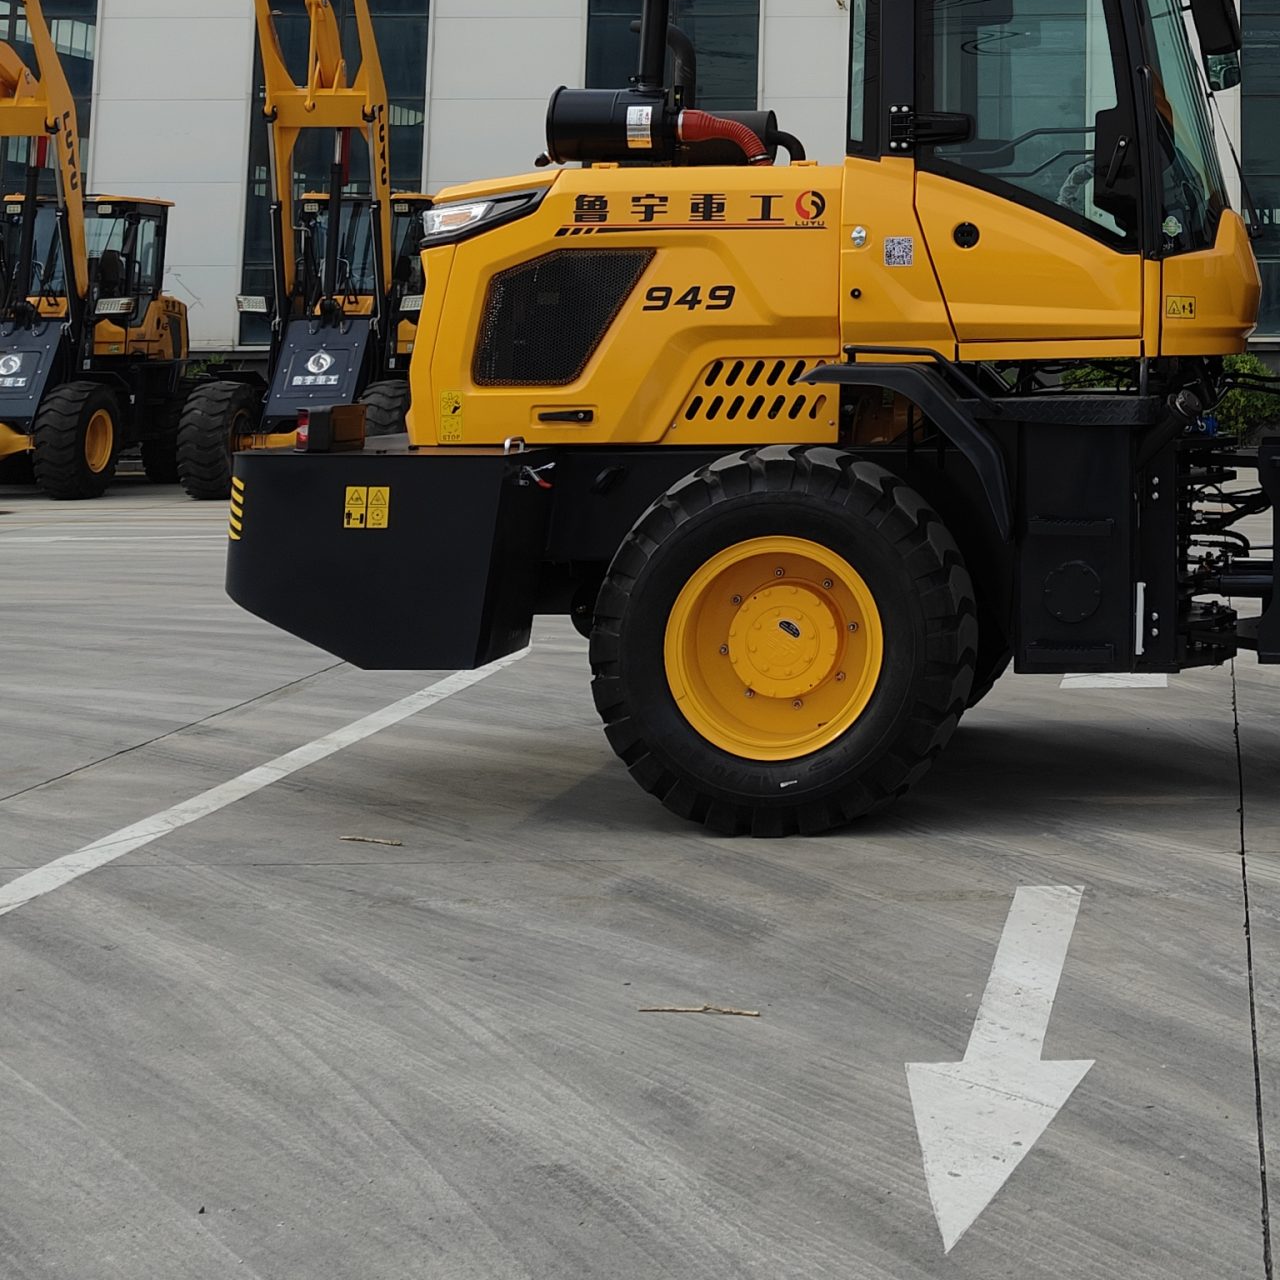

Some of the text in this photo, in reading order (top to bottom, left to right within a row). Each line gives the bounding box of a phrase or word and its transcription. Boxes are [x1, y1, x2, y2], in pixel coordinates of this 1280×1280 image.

[62, 111, 78, 191] LUYU
[377, 104, 387, 186] LUYU
[573, 193, 784, 223] 鲁宇重工
[642, 285, 736, 311] 949
